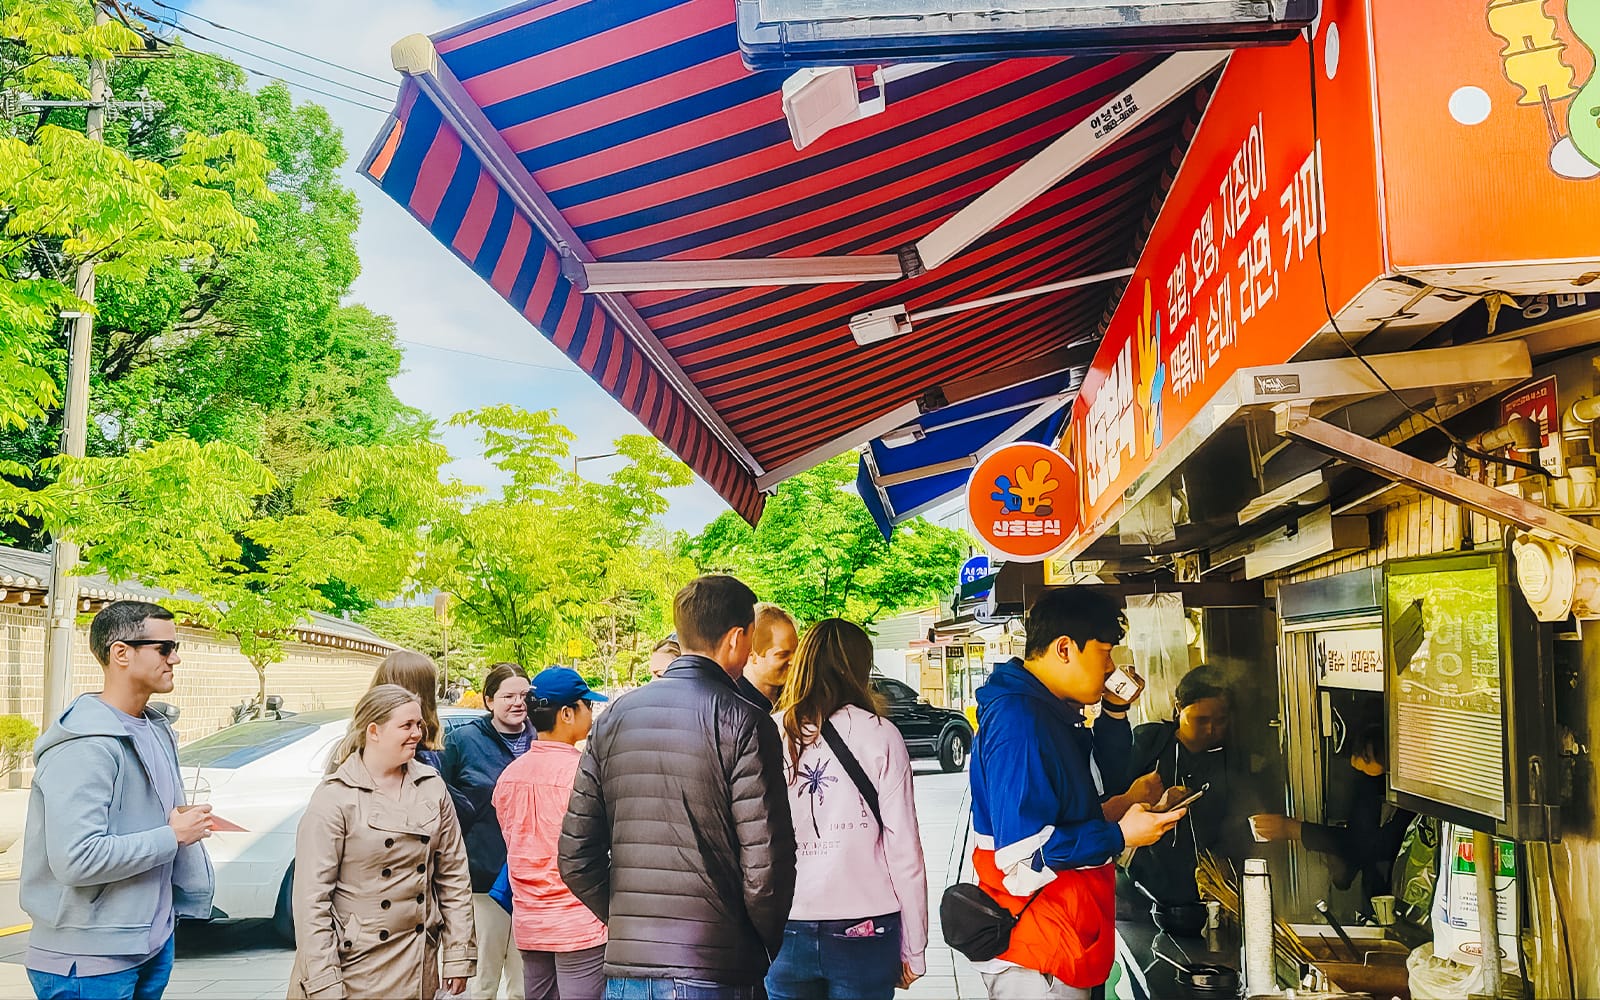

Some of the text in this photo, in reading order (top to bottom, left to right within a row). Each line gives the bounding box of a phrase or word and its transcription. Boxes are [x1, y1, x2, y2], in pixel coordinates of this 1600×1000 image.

[1166, 111, 1267, 334] 김밥, 오뎅, 지짐이
[1206, 272, 1237, 369] 순대,
[1237, 215, 1279, 325] 라면,
[992, 519, 1061, 537] 산호분식
